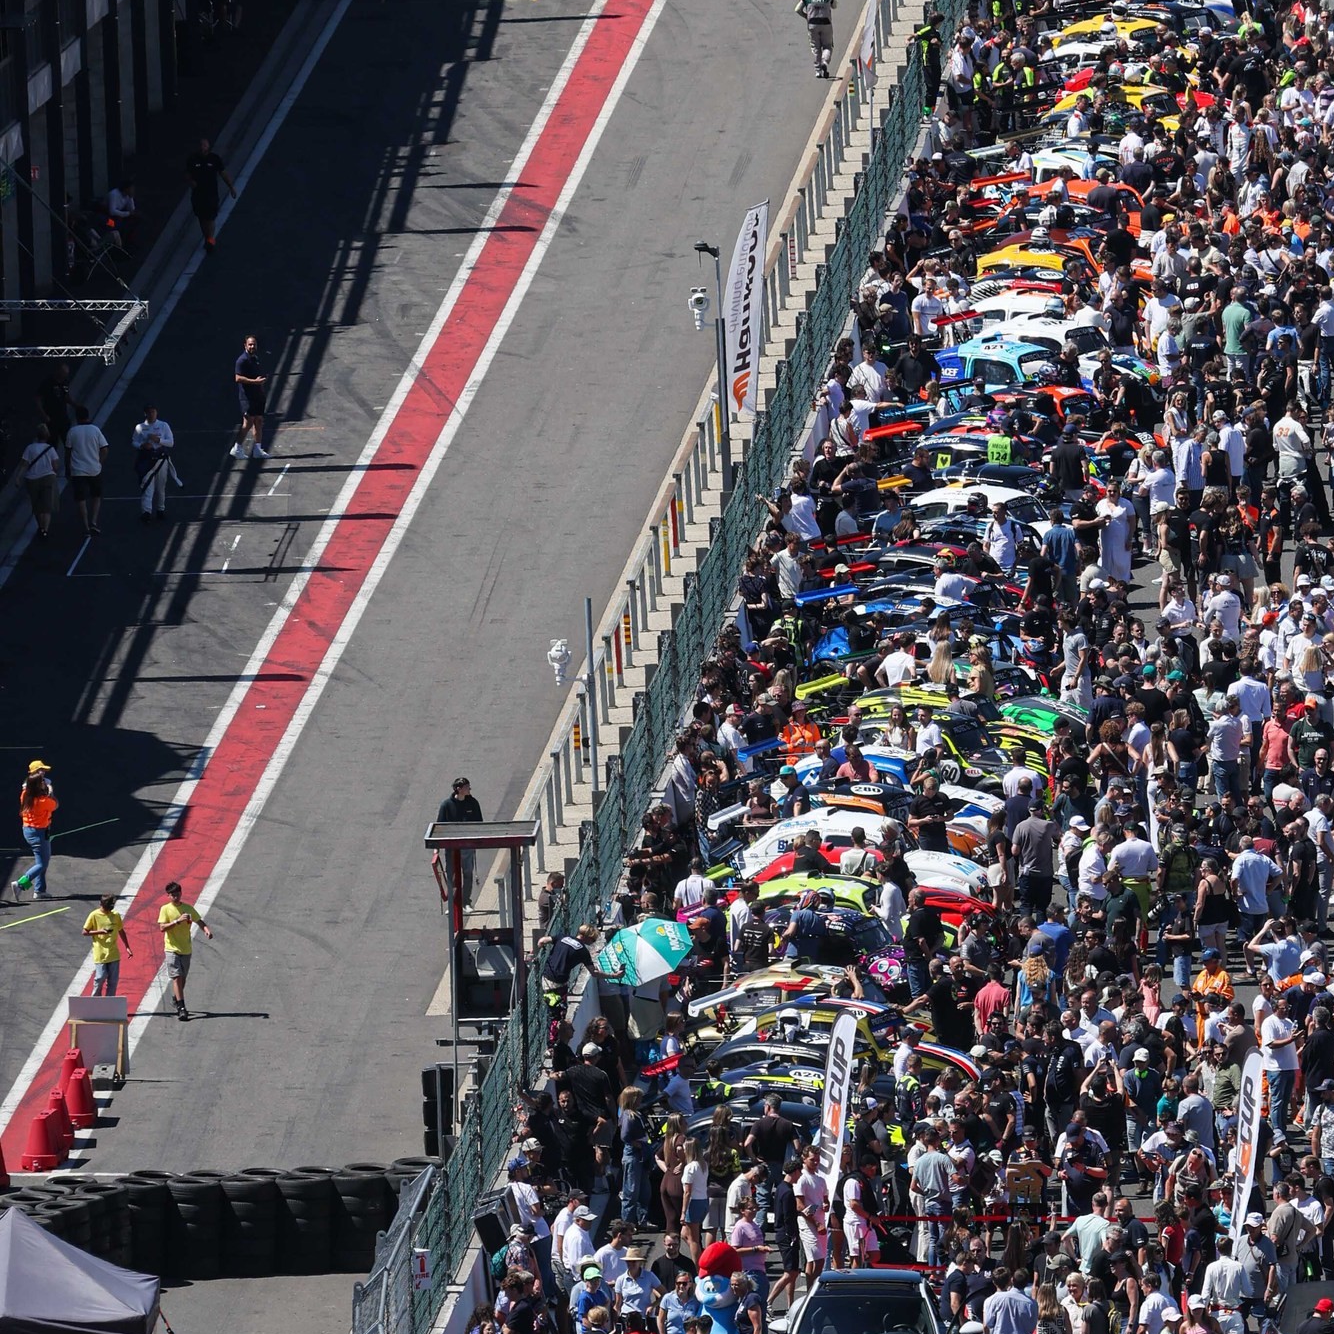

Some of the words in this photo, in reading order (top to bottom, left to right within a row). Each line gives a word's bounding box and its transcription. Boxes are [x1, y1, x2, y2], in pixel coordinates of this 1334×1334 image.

[991, 452, 1007, 461] 124
[793, 1069, 821, 1079] 424
[829, 1036, 848, 1105] CUP
[1241, 1075, 1257, 1145] CUP
